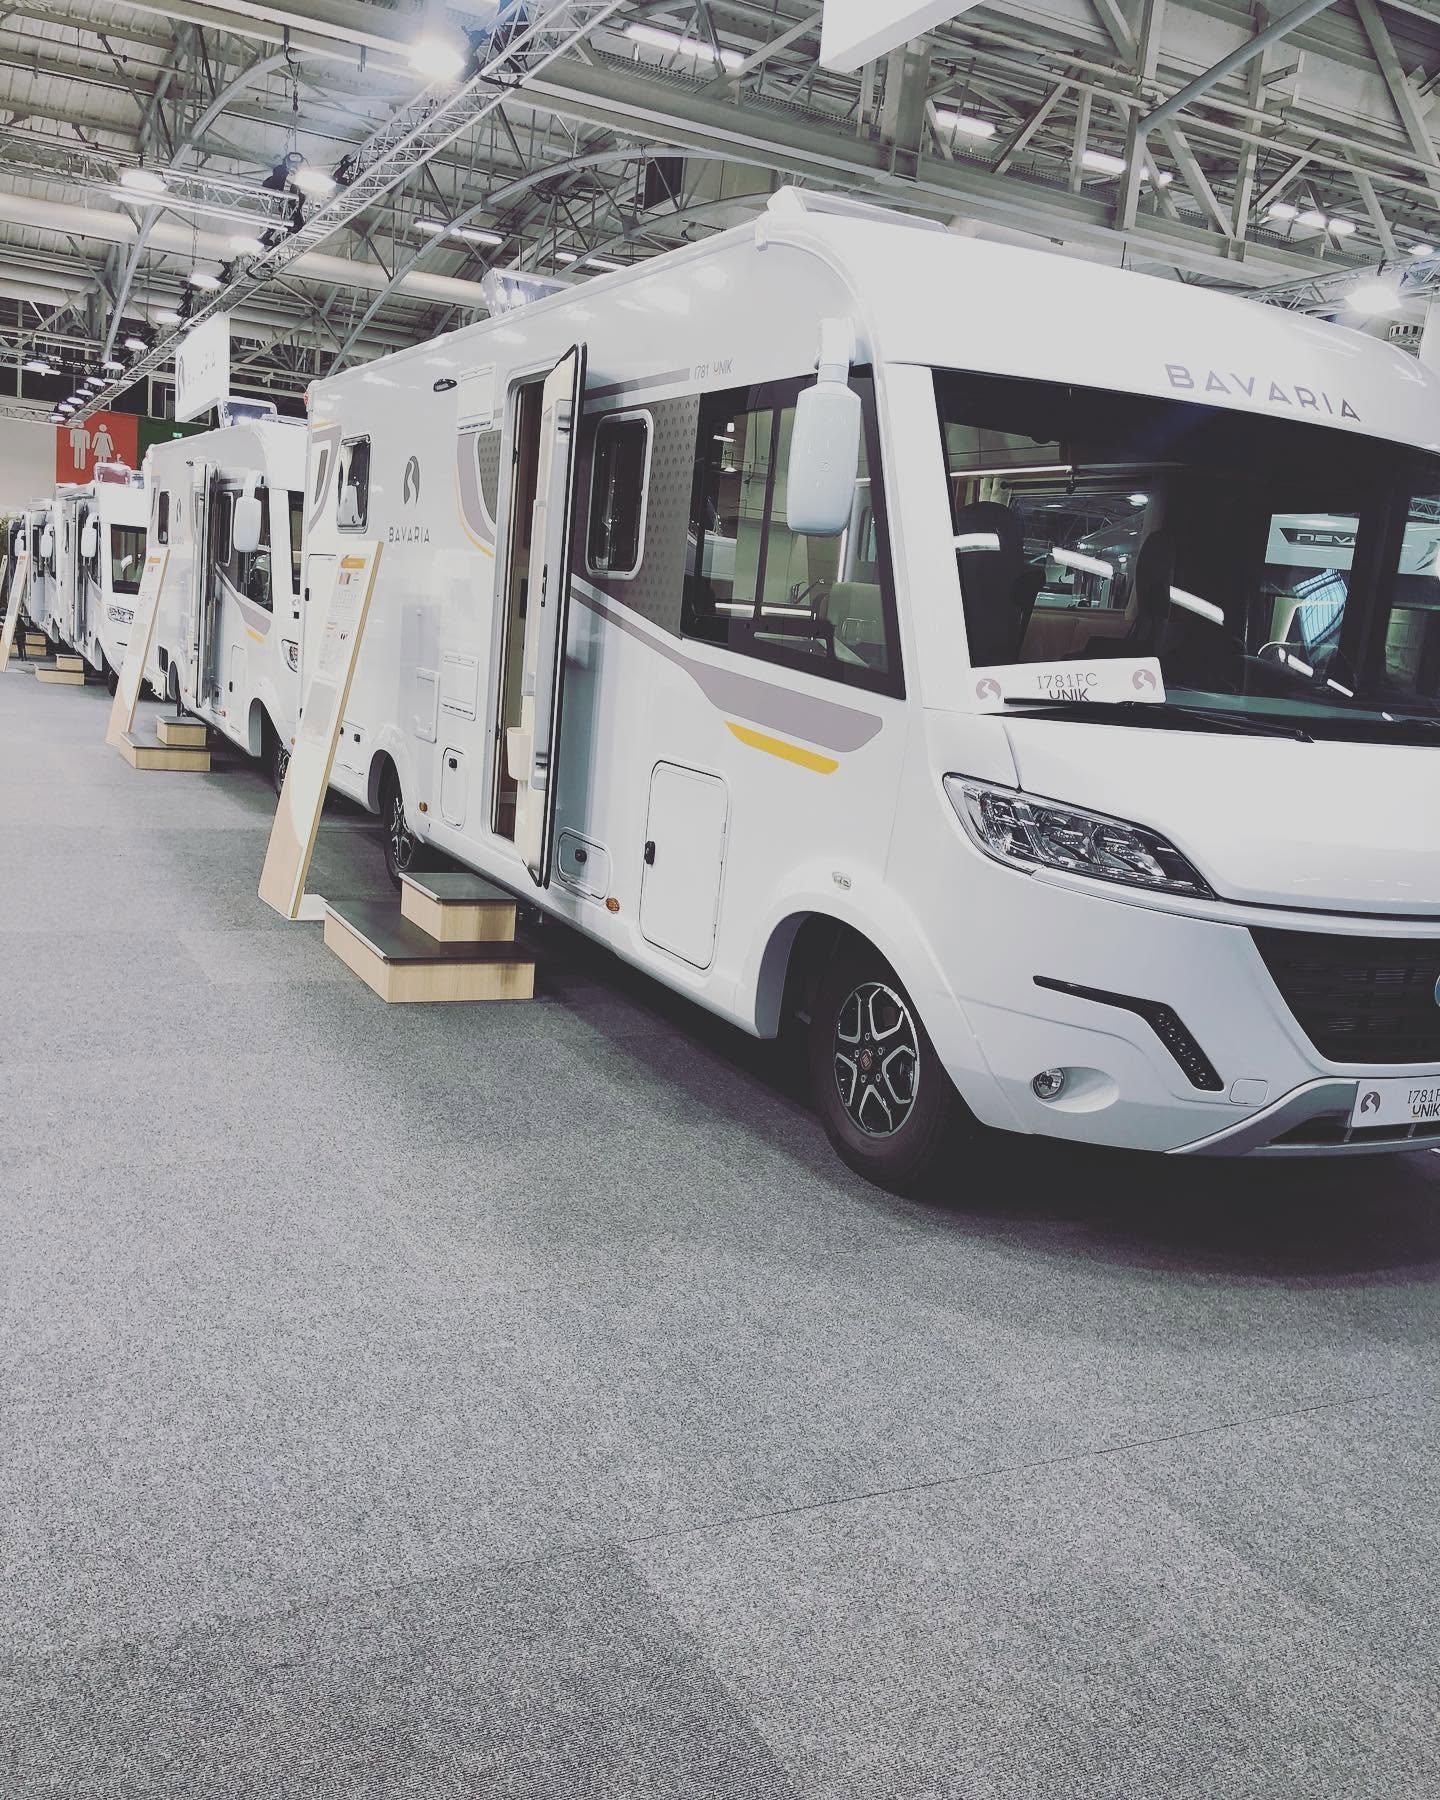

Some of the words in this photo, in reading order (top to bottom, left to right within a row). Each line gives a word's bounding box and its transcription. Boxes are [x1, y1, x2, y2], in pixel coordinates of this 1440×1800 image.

[1165, 363, 1361, 422] BAVARIA
[388, 526, 430, 543] BAVARIA
[1036, 672, 1099, 690] I781FC
[1049, 688, 1090, 702] UNIK
[1412, 1102, 1440, 1118] UNIK
